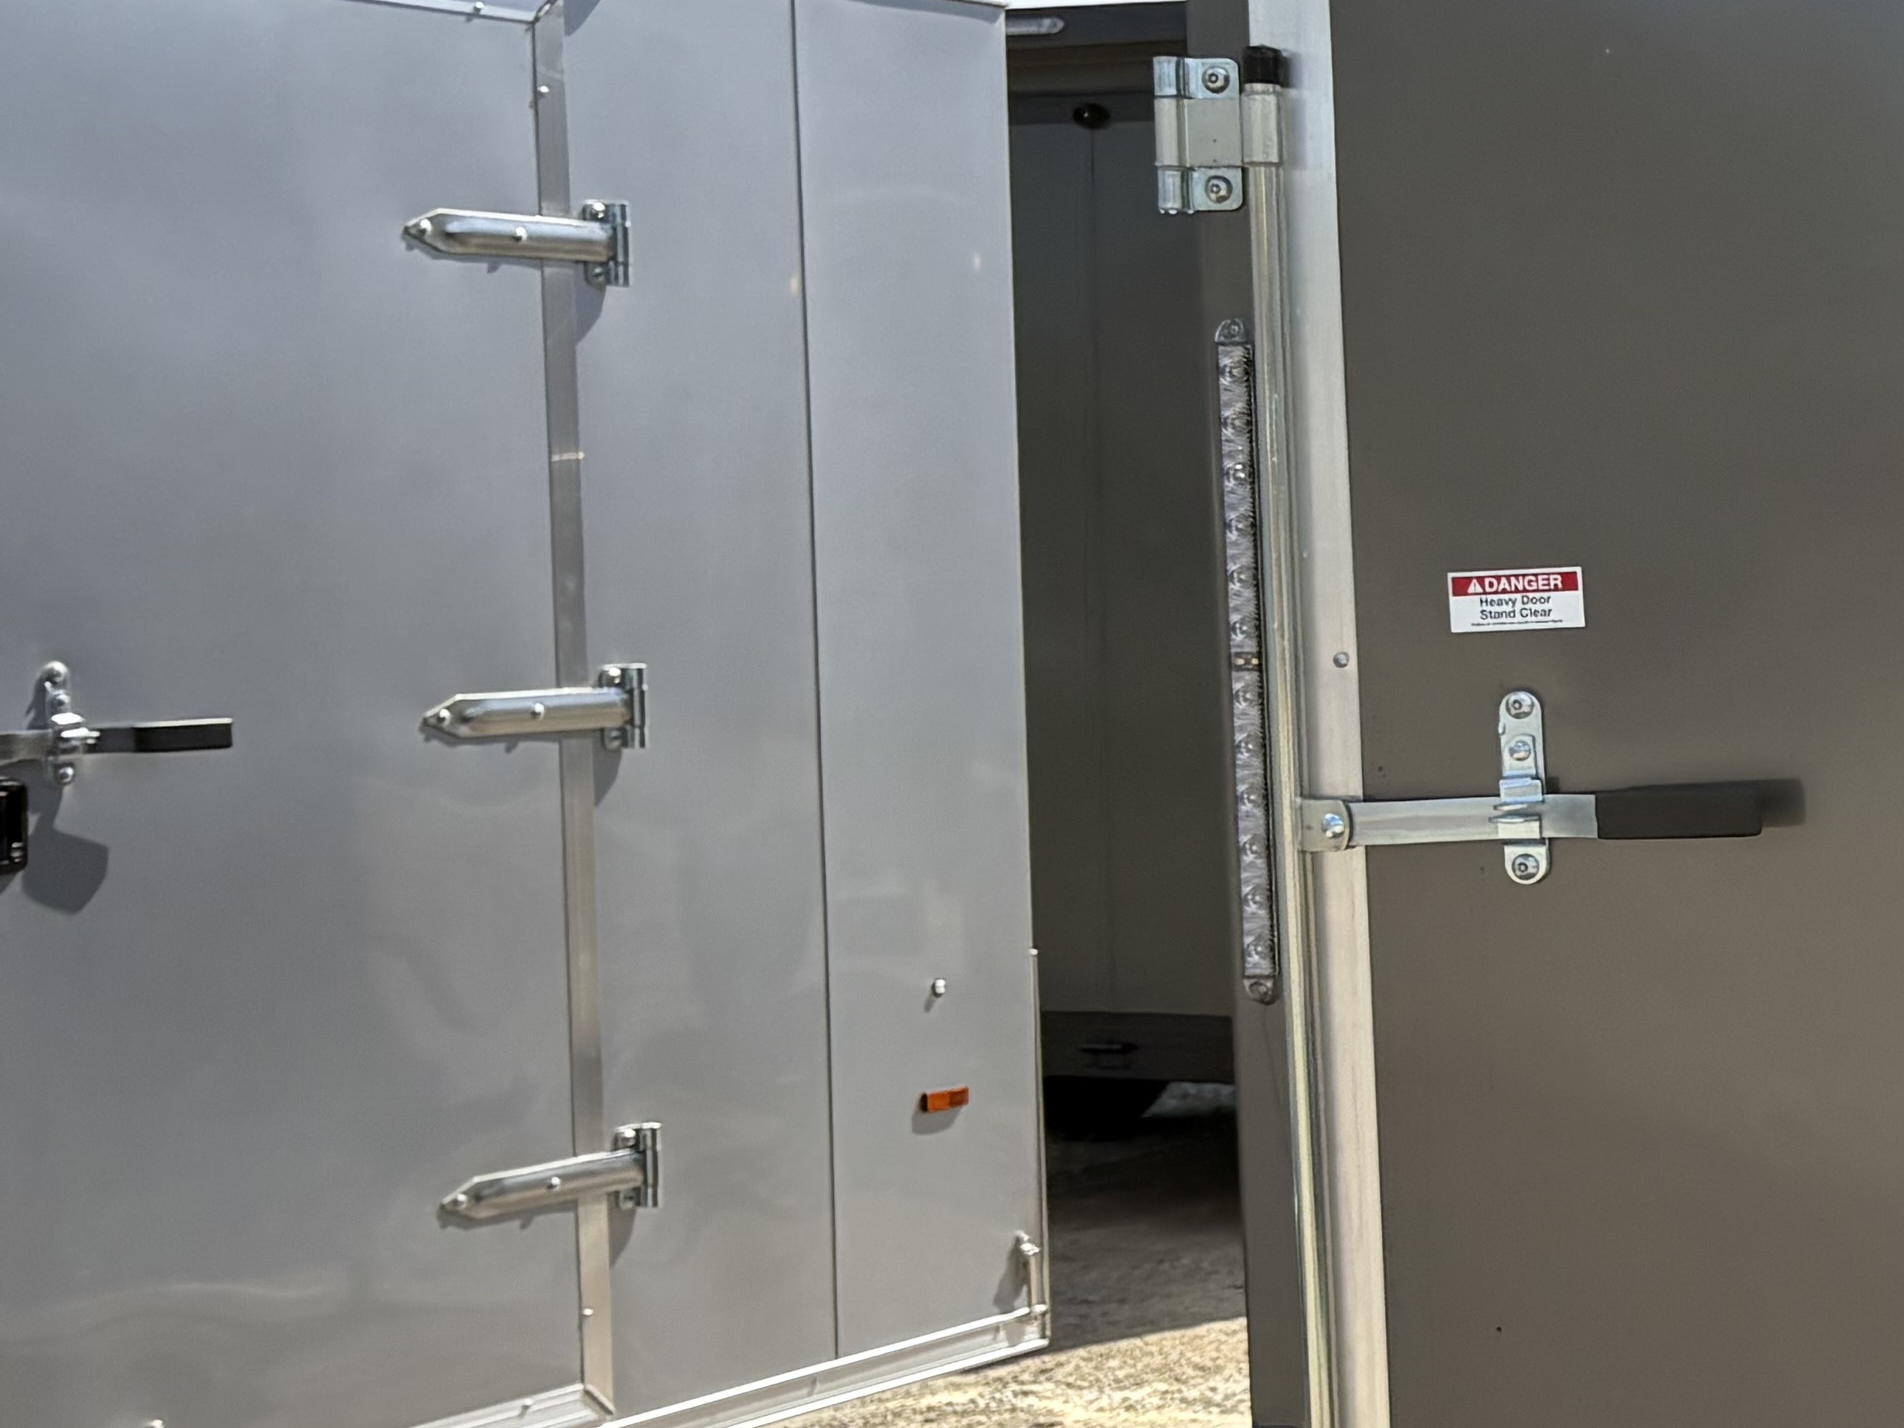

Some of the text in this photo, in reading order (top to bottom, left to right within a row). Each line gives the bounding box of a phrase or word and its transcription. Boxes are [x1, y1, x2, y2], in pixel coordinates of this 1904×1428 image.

[1484, 574, 1563, 593] DANGER
[1479, 595, 1551, 608] Heavy Door
[1480, 608, 1552, 620] Stand Clear
